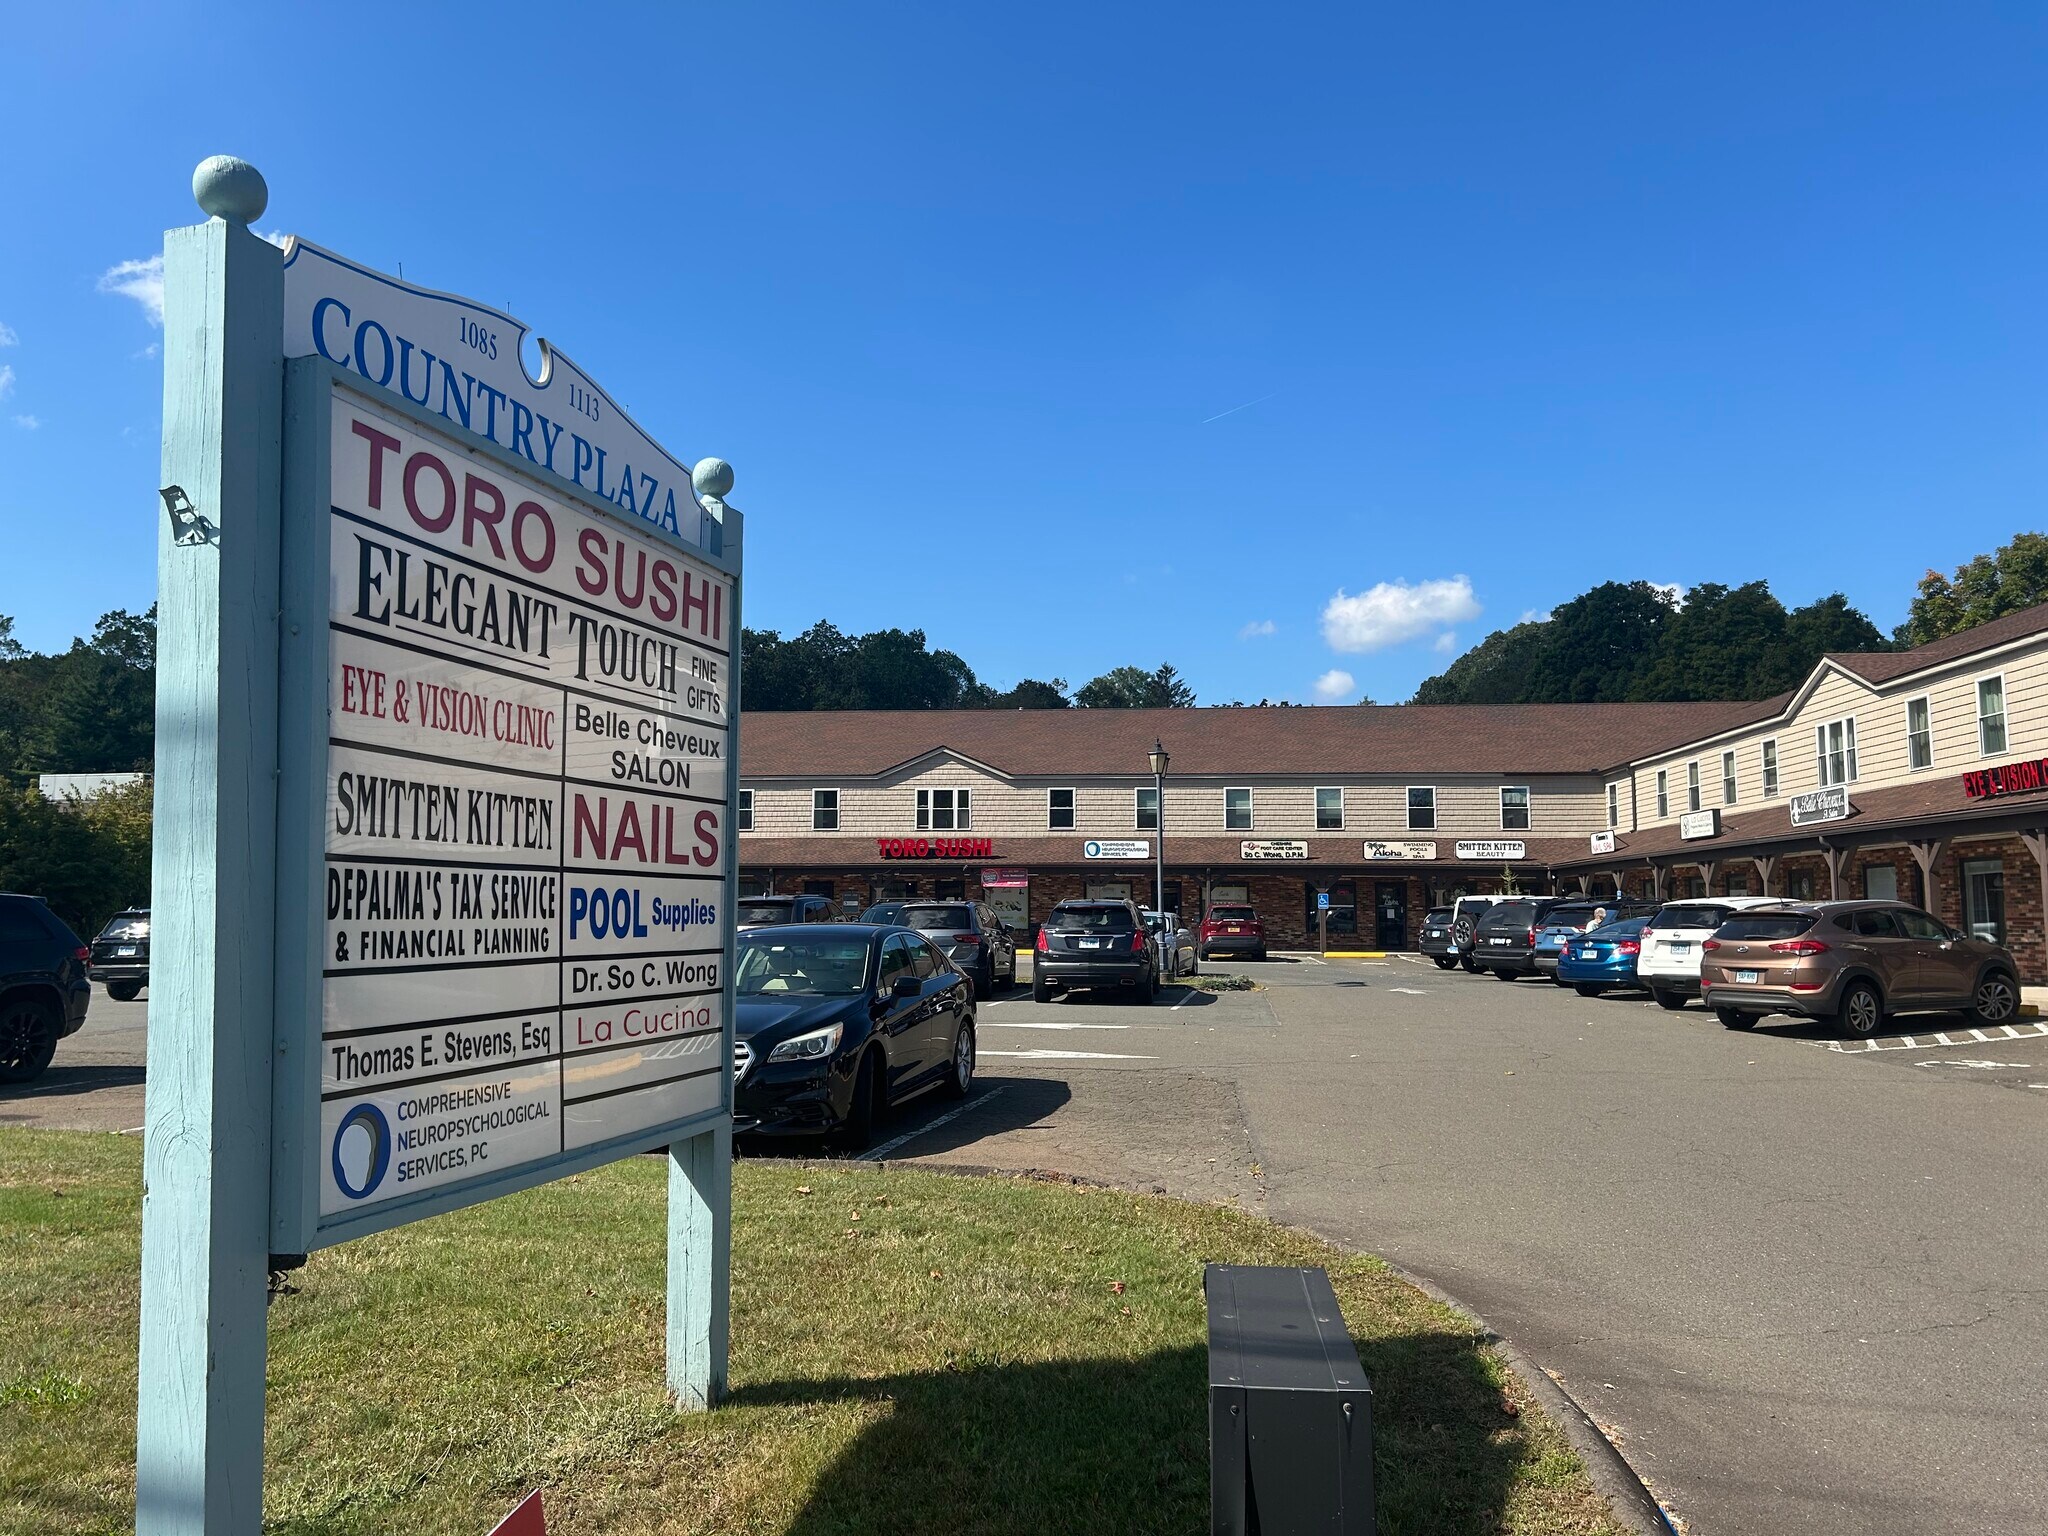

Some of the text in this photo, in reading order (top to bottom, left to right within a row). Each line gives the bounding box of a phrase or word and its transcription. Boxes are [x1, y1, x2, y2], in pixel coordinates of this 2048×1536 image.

[460, 317, 498, 361] 1085
[312, 297, 682, 538] COUNTRY PLAZA
[568, 383, 600, 422] 1113
[351, 419, 722, 641] TORO SUSHI
[353, 532, 679, 695] ELEGANT TOUCH
[691, 655, 718, 683] FINE
[341, 664, 555, 750] EYE & VISION CLINIC
[687, 689, 721, 714] GIFTS
[575, 703, 720, 758] Belle Cheveux
[611, 750, 691, 789] SALON
[1963, 771, 1986, 798] EYE
[1988, 768, 1998, 794] &
[1997, 761, 2040, 792] VISION
[336, 771, 553, 851] SMITTEN KITTEN
[573, 793, 719, 867] NAILS
[878, 838, 993, 857] TORO SUSHI
[1373, 848, 1403, 857] Aloha
[1458, 842, 1523, 851] SMITTEN KITTEN
[327, 867, 556, 921] DEPALMA'S TAX SERVICE
[569, 886, 716, 940] POOL Supplies
[335, 926, 550, 962] & FINANCIAL PLANNING
[572, 960, 718, 994] Dr. So C. Wong
[577, 1003, 711, 1046] La Cucina
[332, 1020, 551, 1081] Thomas E. Stevens, Esq
[397, 1081, 512, 1121] COMPREHENSIVE
[397, 1100, 550, 1152] NEUROPSYCHOLOGICAL
[397, 1141, 488, 1183] SERVICES, PC
